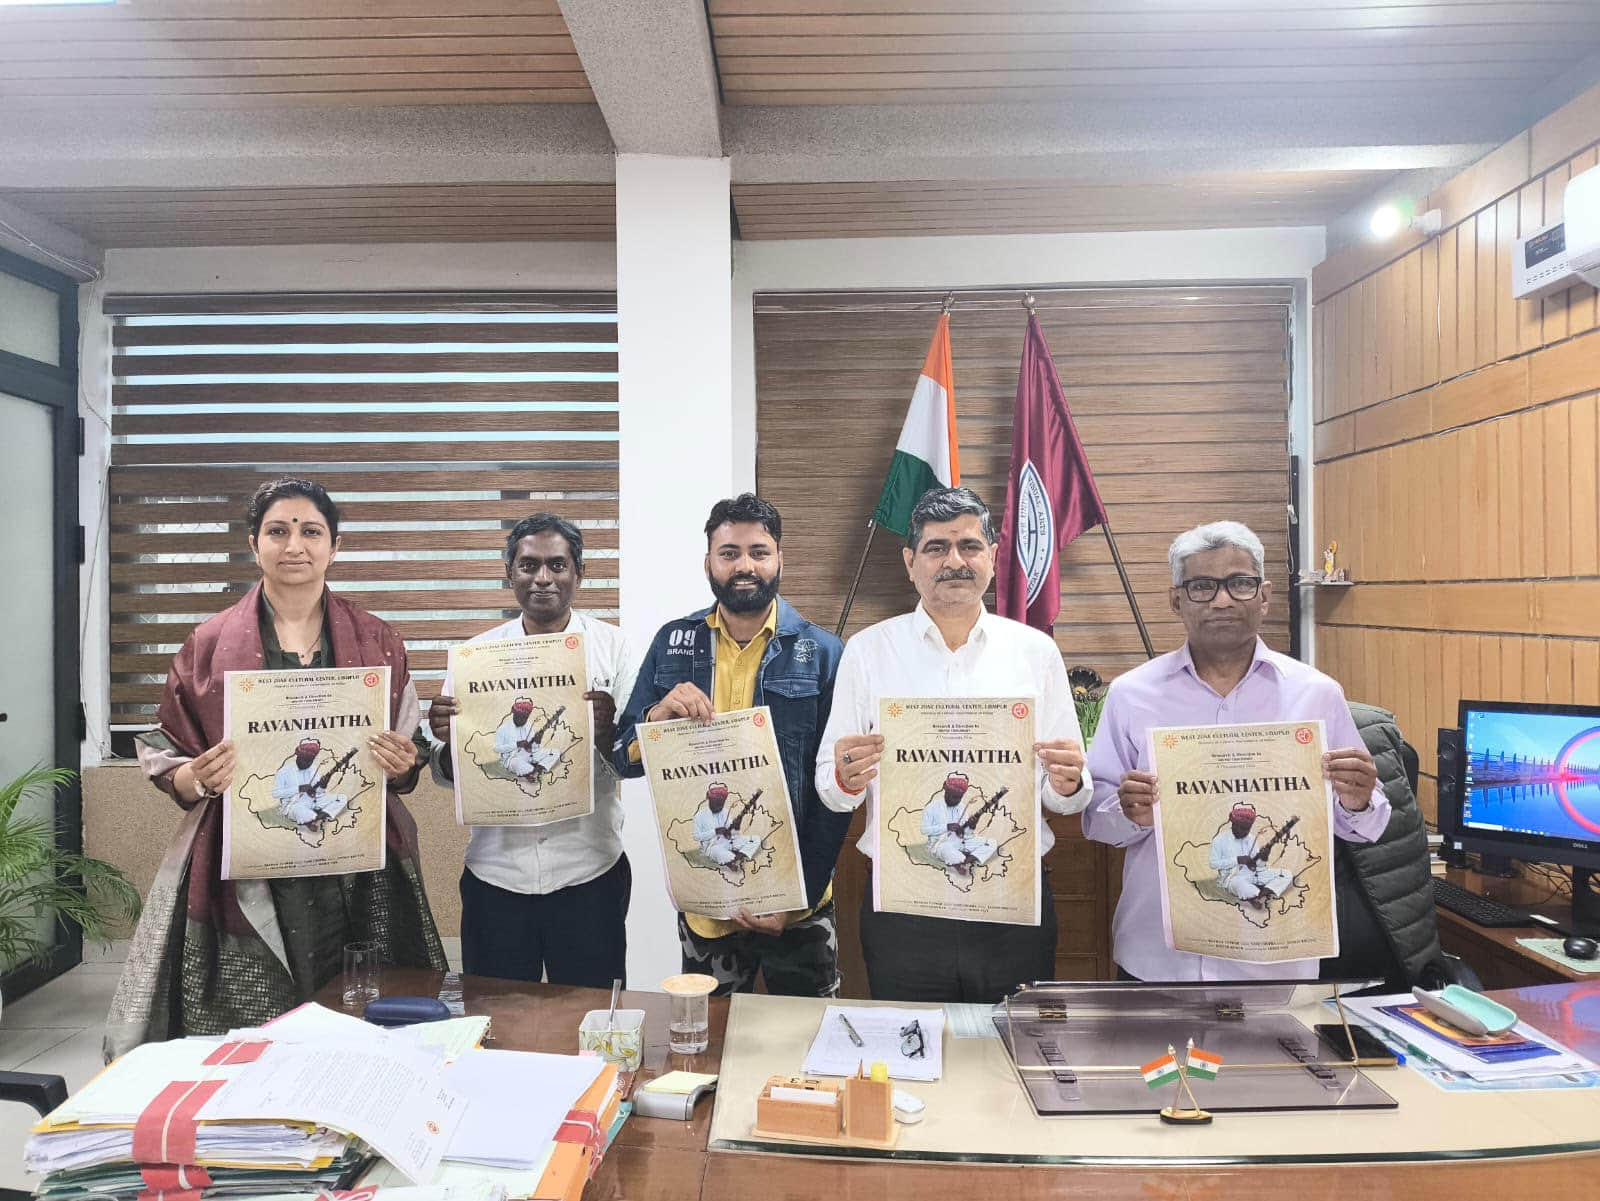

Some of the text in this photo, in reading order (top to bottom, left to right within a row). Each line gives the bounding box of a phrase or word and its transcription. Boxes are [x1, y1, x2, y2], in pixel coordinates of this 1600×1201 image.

[669, 629, 696, 647] 09
[667, 648, 694, 656] BRAND
[469, 674, 576, 694] RAVANHATTHA
[248, 714, 372, 734] RAVANHATTHA
[896, 748, 1022, 764] RAVANHATTHA
[662, 754, 770, 780] RAVANHATTHA
[1176, 776, 1310, 795] RAVANHATTHA
